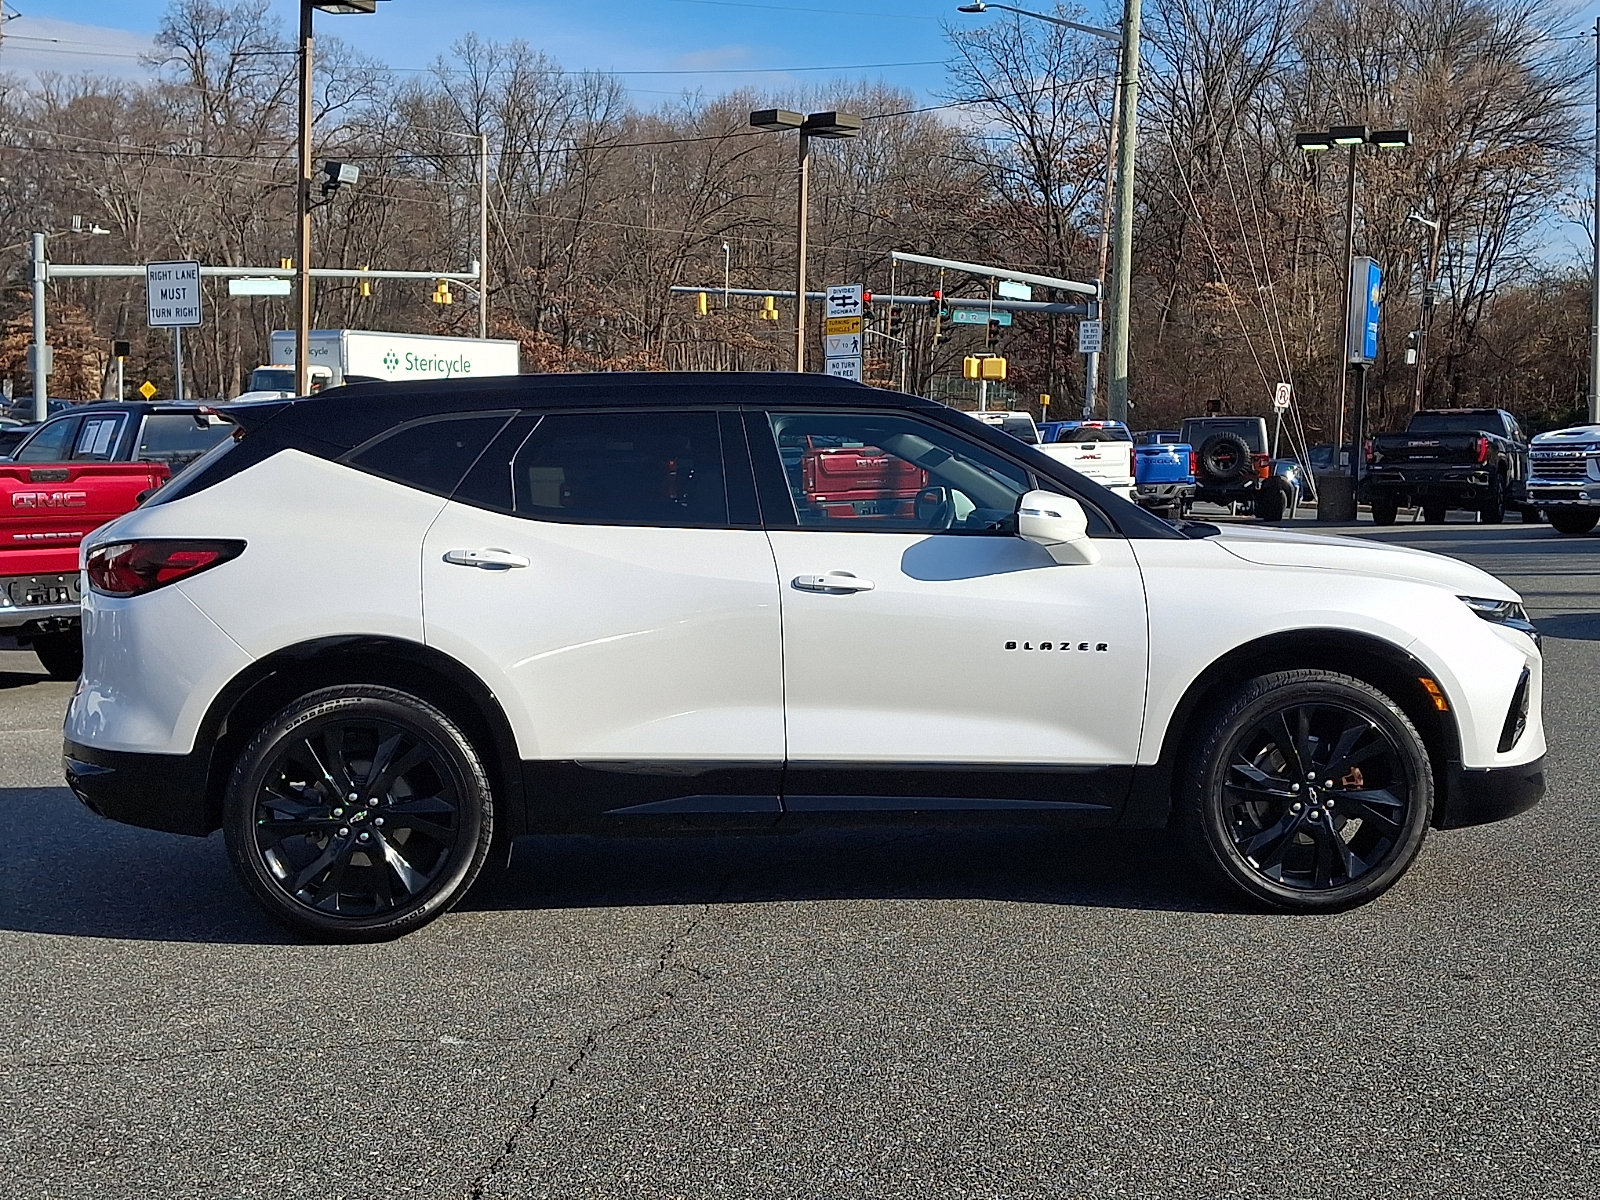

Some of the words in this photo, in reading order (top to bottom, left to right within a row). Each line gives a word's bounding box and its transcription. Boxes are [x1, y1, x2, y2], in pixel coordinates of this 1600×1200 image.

[150, 270, 171, 281] RIGHT
[175, 269, 196, 280] LANE
[160, 287, 187, 300] MUST
[151, 308, 172, 318] TURN
[175, 306, 198, 317] RIGHT
[405, 352, 471, 379] Stericycle
[841, 361, 856, 369] TURN
[842, 369, 854, 377] RED
[1407, 440, 1440, 448] GMC
[856, 459, 889, 467] GMC
[12, 492, 87, 508] GMC
[1004, 641, 1109, 652] BLAZER
